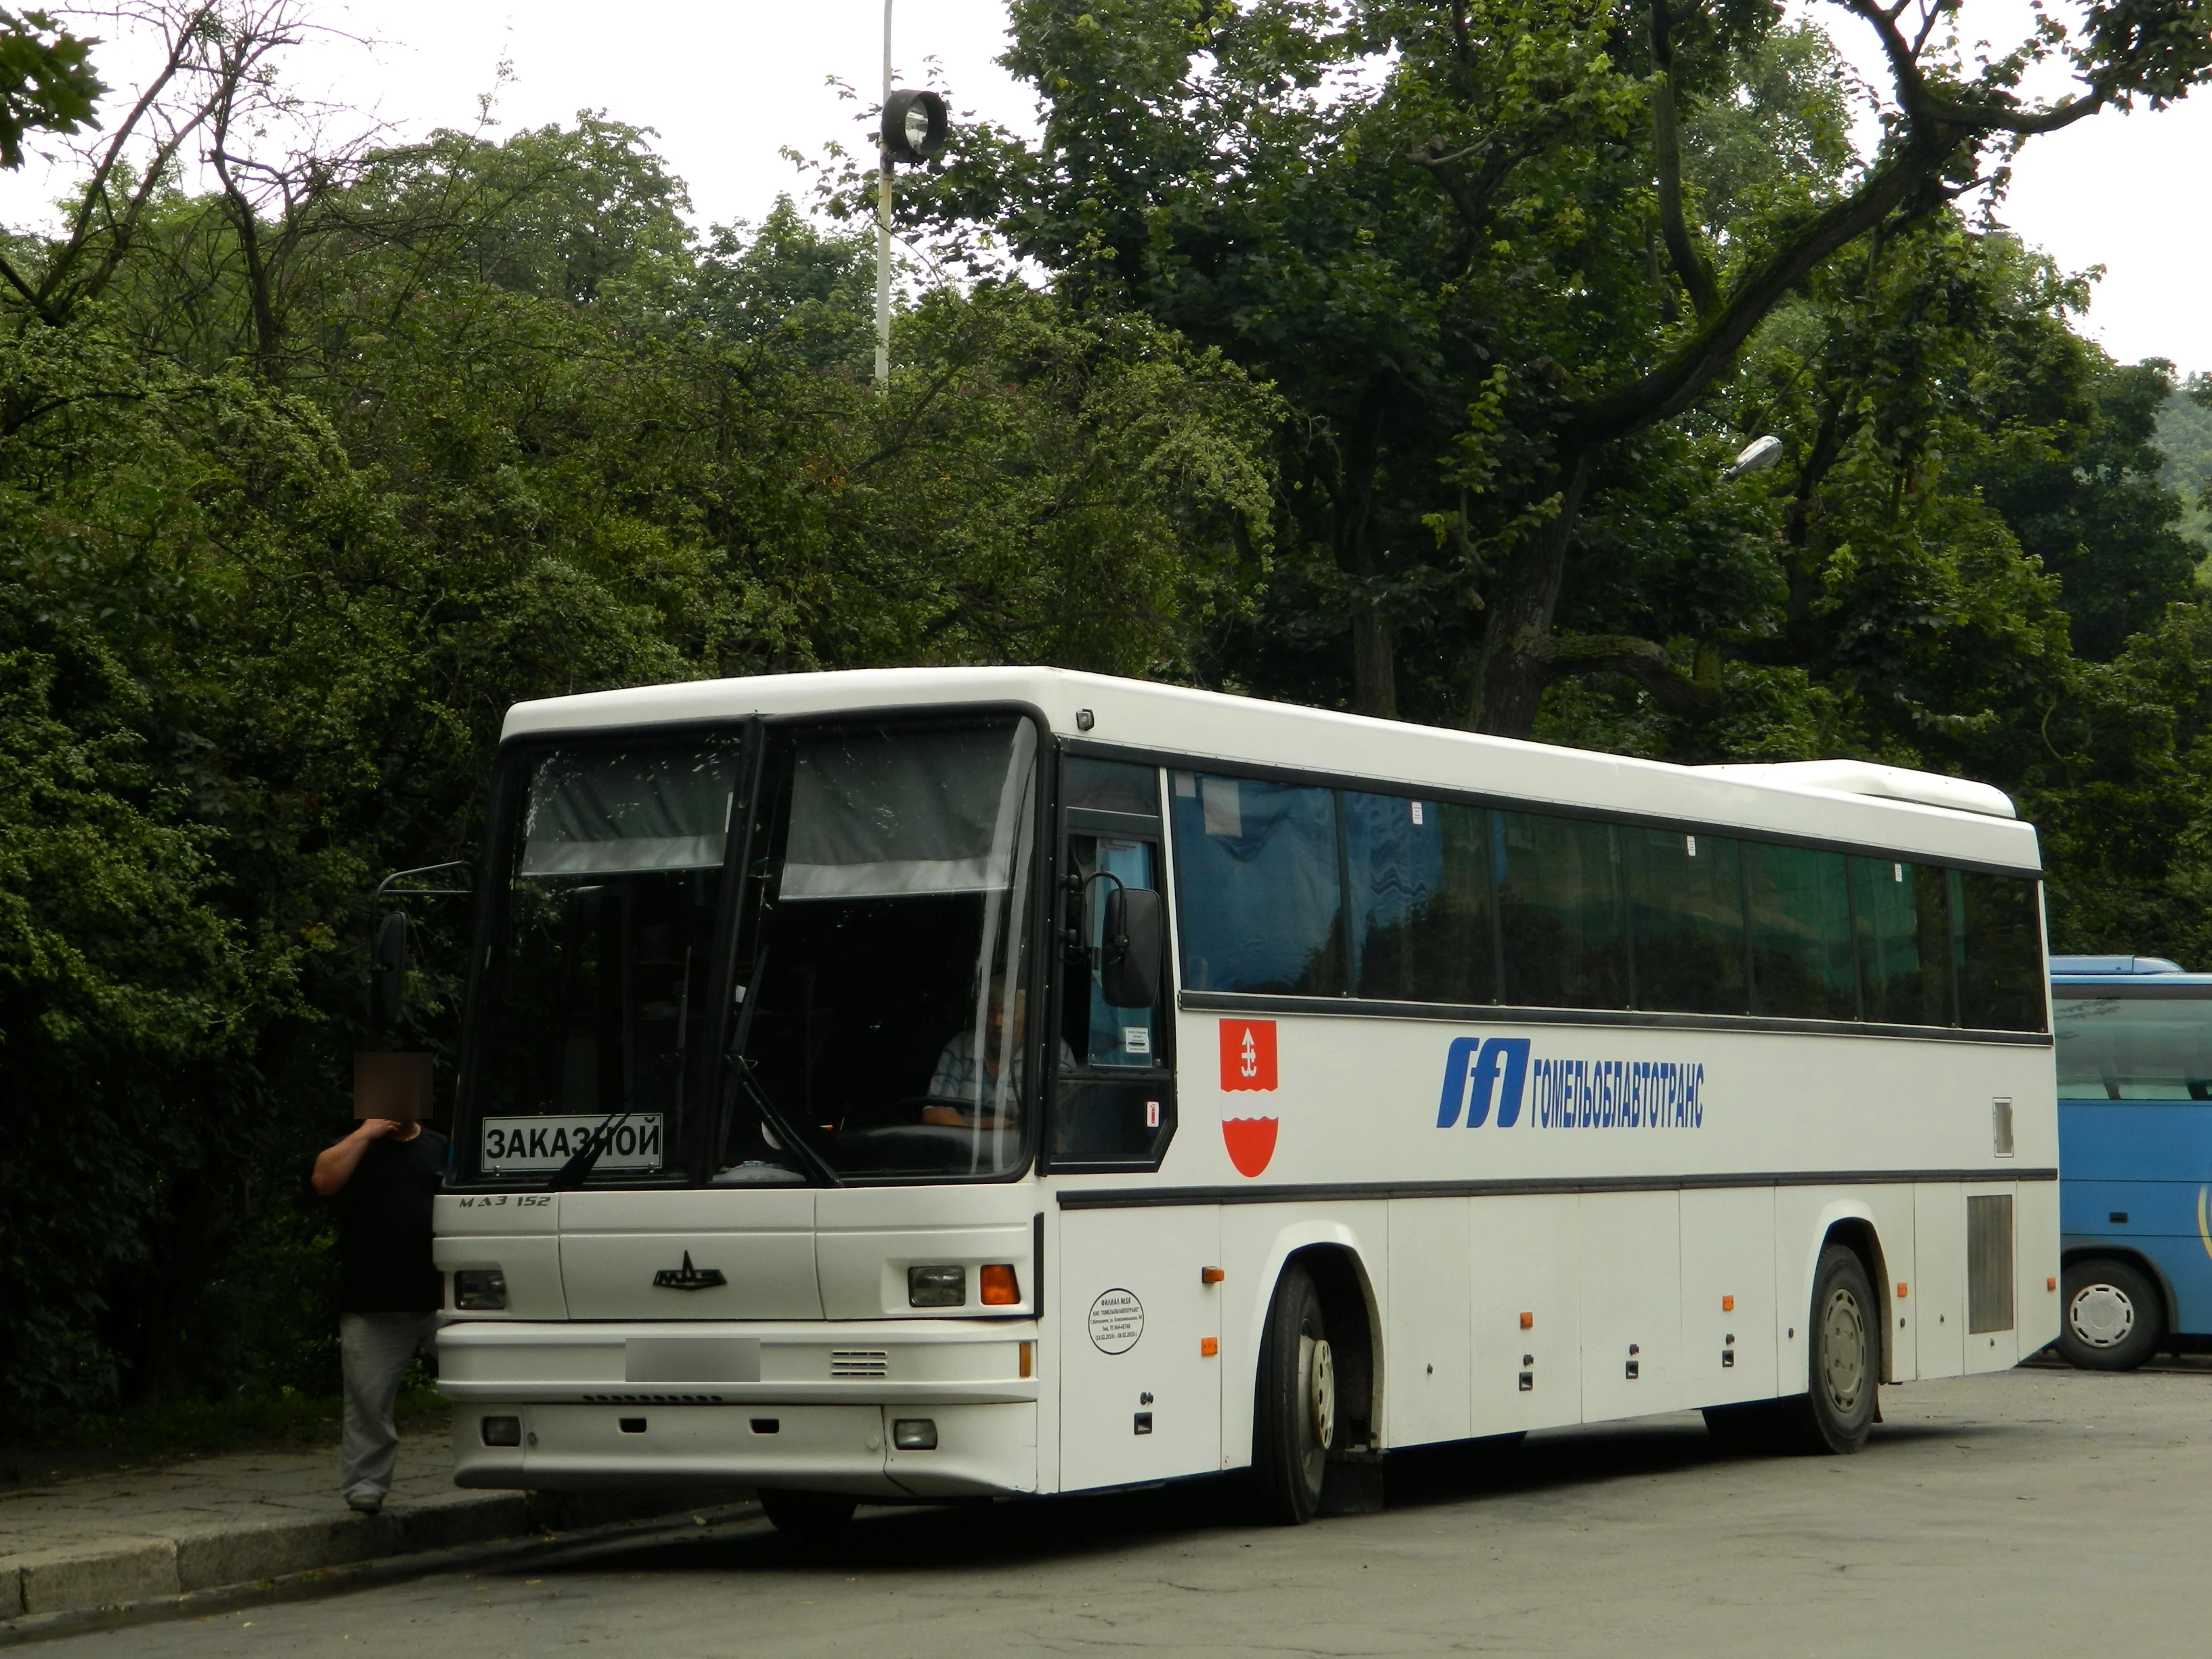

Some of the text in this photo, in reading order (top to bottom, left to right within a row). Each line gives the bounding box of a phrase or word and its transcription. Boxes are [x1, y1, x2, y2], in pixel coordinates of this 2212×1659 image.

[1531, 1058, 1704, 1130] ГОМЕЛЬОБЛАВТОТРАНС
[485, 1116, 659, 1160] ЗАКАЗНОЙ
[459, 1195, 551, 1208] МАЗ 152
[1101, 1298, 1120, 1306] ФИЛИАЛ
